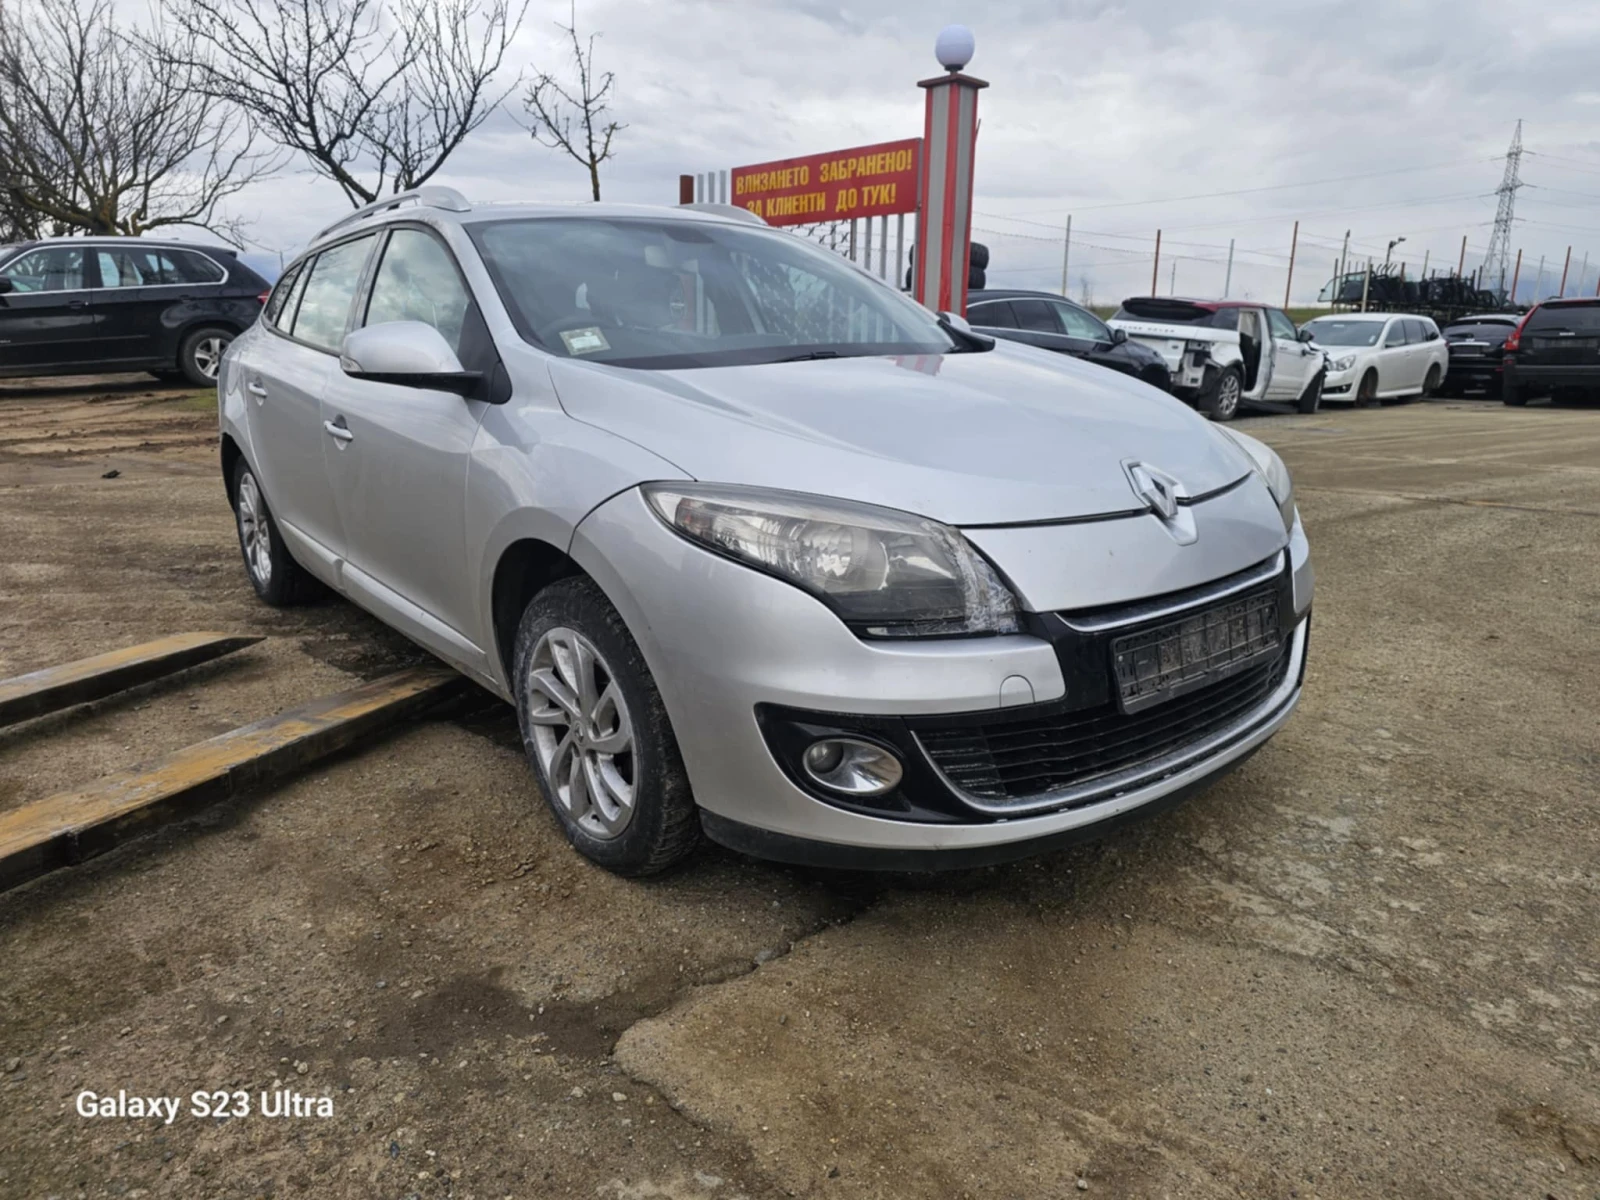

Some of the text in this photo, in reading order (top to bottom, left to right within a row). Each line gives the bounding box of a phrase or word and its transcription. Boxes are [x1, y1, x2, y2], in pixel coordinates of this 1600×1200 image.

[736, 149, 912, 195] ВЛИЗАНЕТО ЗАБРАНЕНО!
[766, 191, 825, 217] КЛИЕНТИ
[835, 188, 857, 212] ДО
[862, 183, 896, 207] ТУК!
